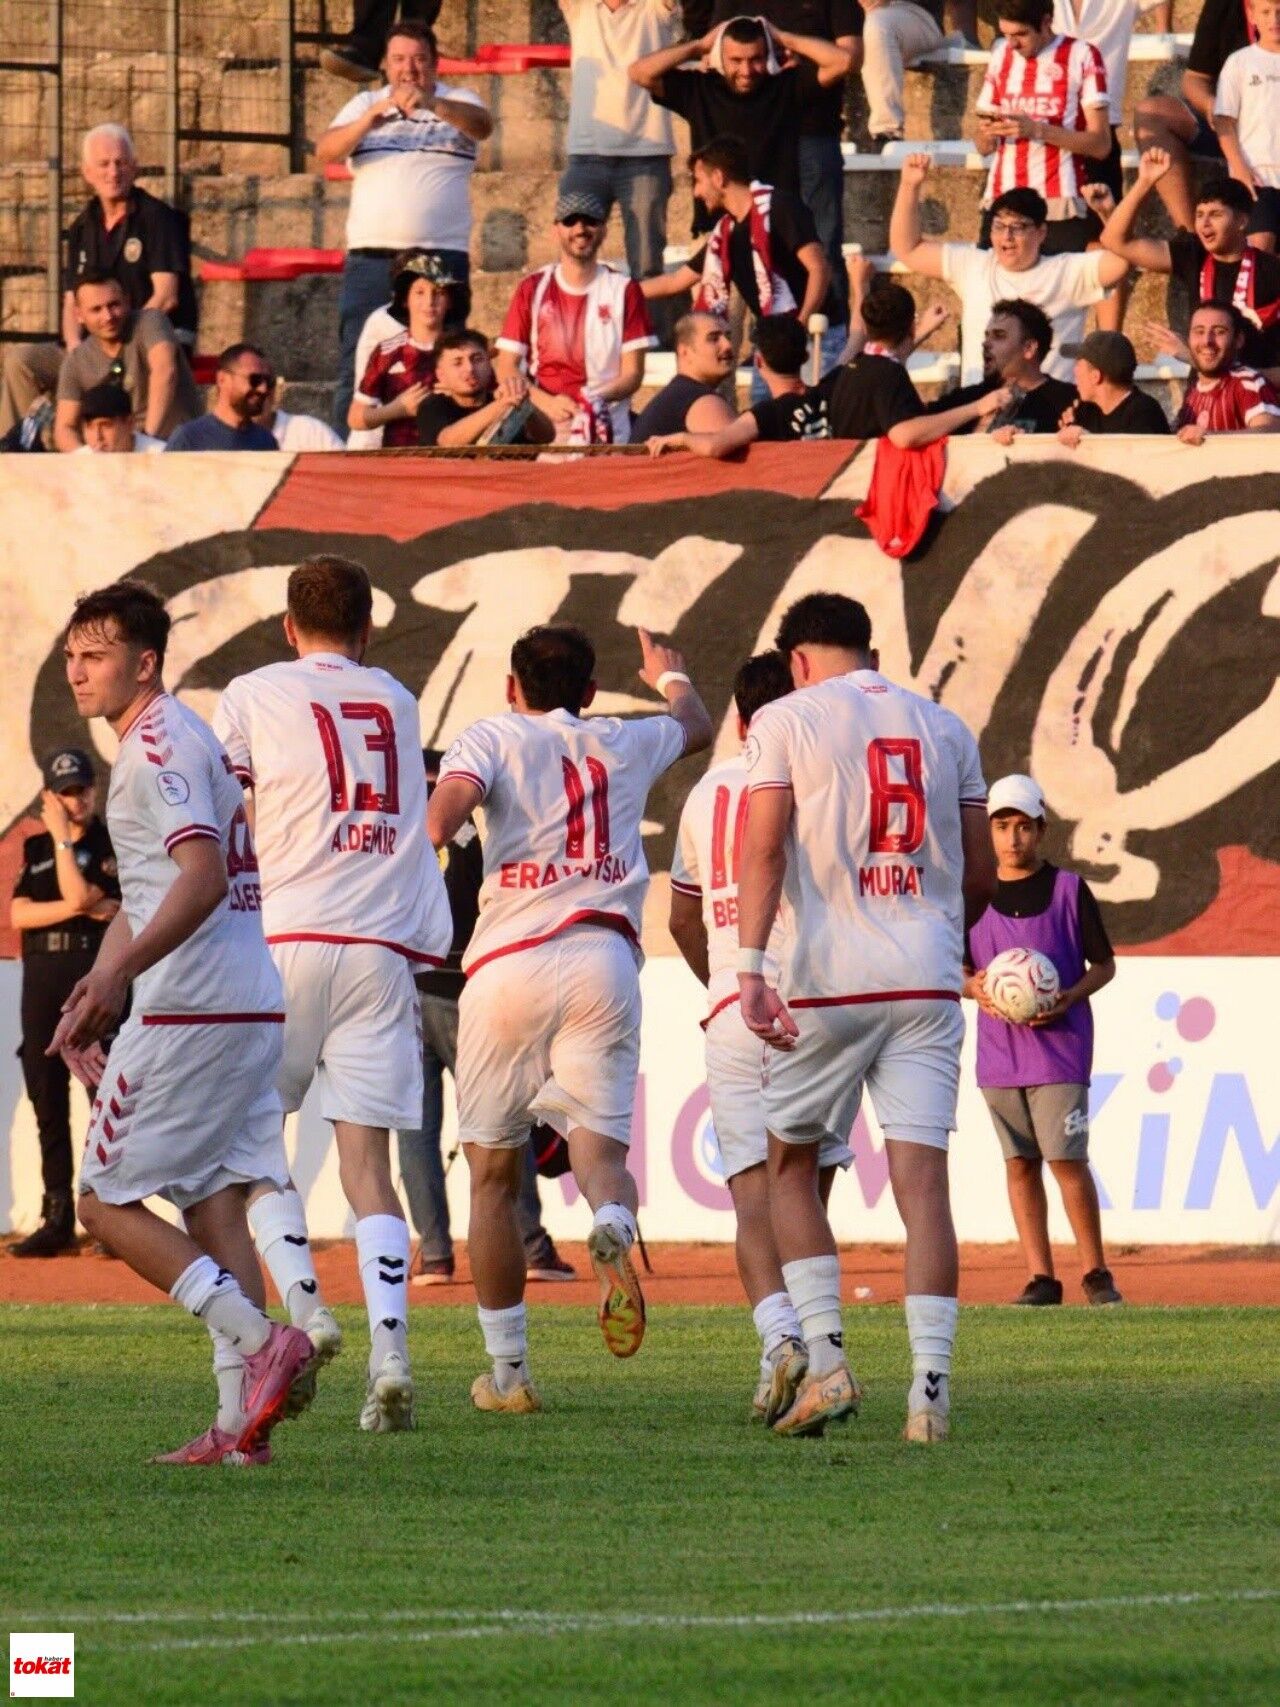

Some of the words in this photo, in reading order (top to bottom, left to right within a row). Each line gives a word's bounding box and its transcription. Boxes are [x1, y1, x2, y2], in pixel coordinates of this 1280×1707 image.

[310, 702, 400, 815] 13
[561, 755, 610, 859] 11
[867, 738, 927, 854] 8
[331, 820, 398, 856] A.DEMİR
[859, 865, 925, 897] MURAT
